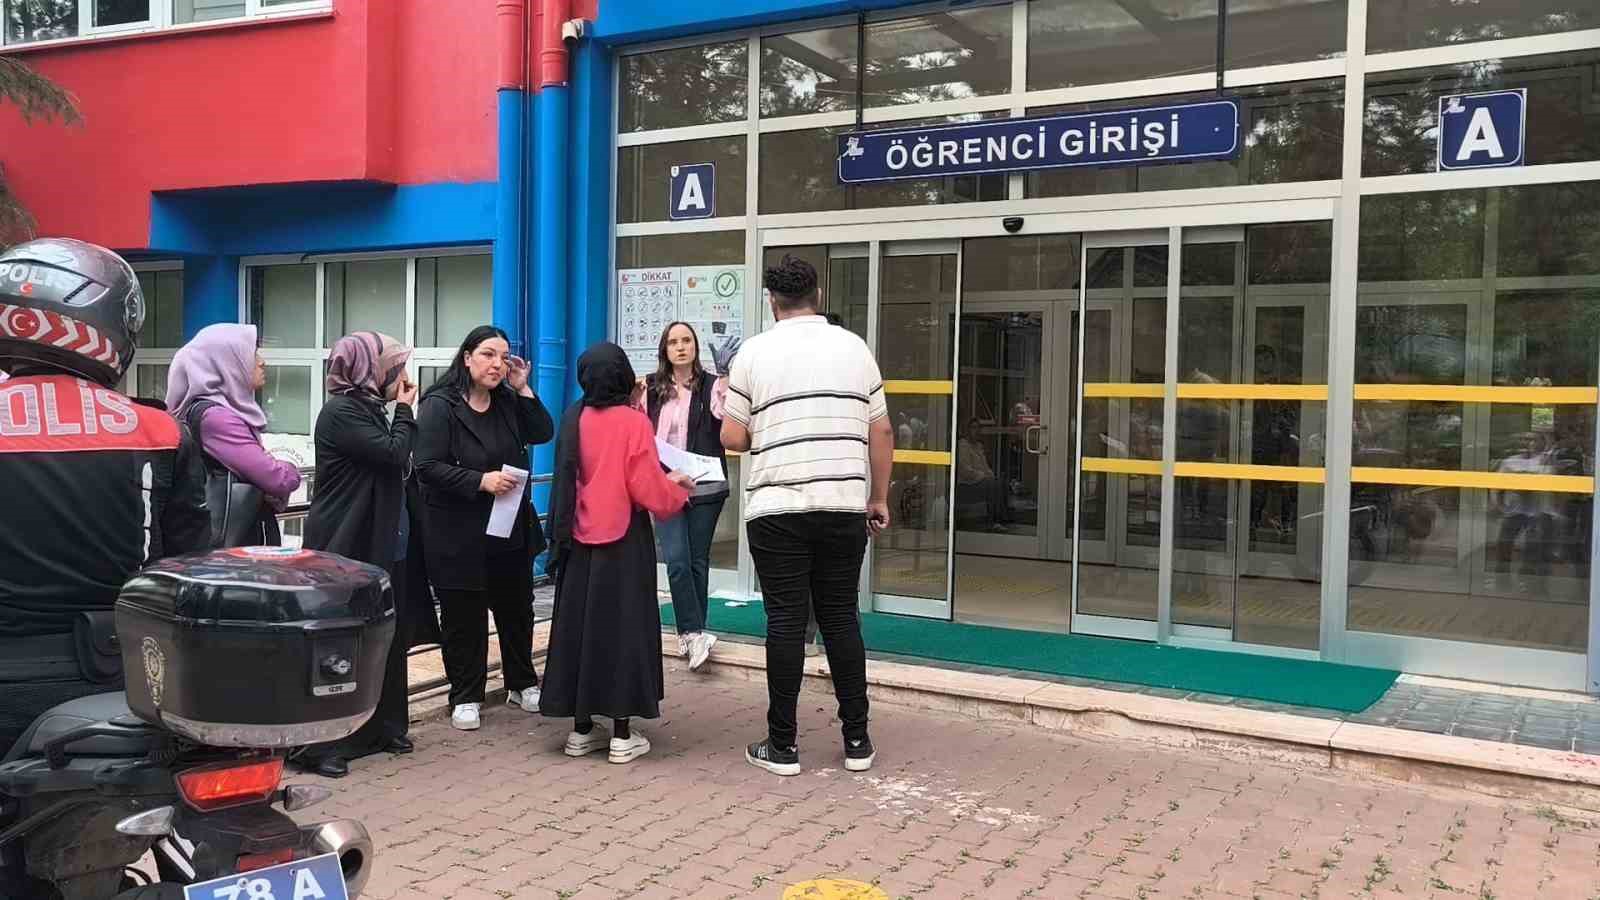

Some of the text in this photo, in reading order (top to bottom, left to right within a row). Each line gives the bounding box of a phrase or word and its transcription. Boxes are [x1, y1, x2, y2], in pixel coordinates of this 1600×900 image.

[886, 113, 1179, 170] ÖĞRENCİ GİRİŞİ
[1456, 107, 1504, 160] A
[678, 172, 706, 211] A
[293, 867, 326, 900] A
